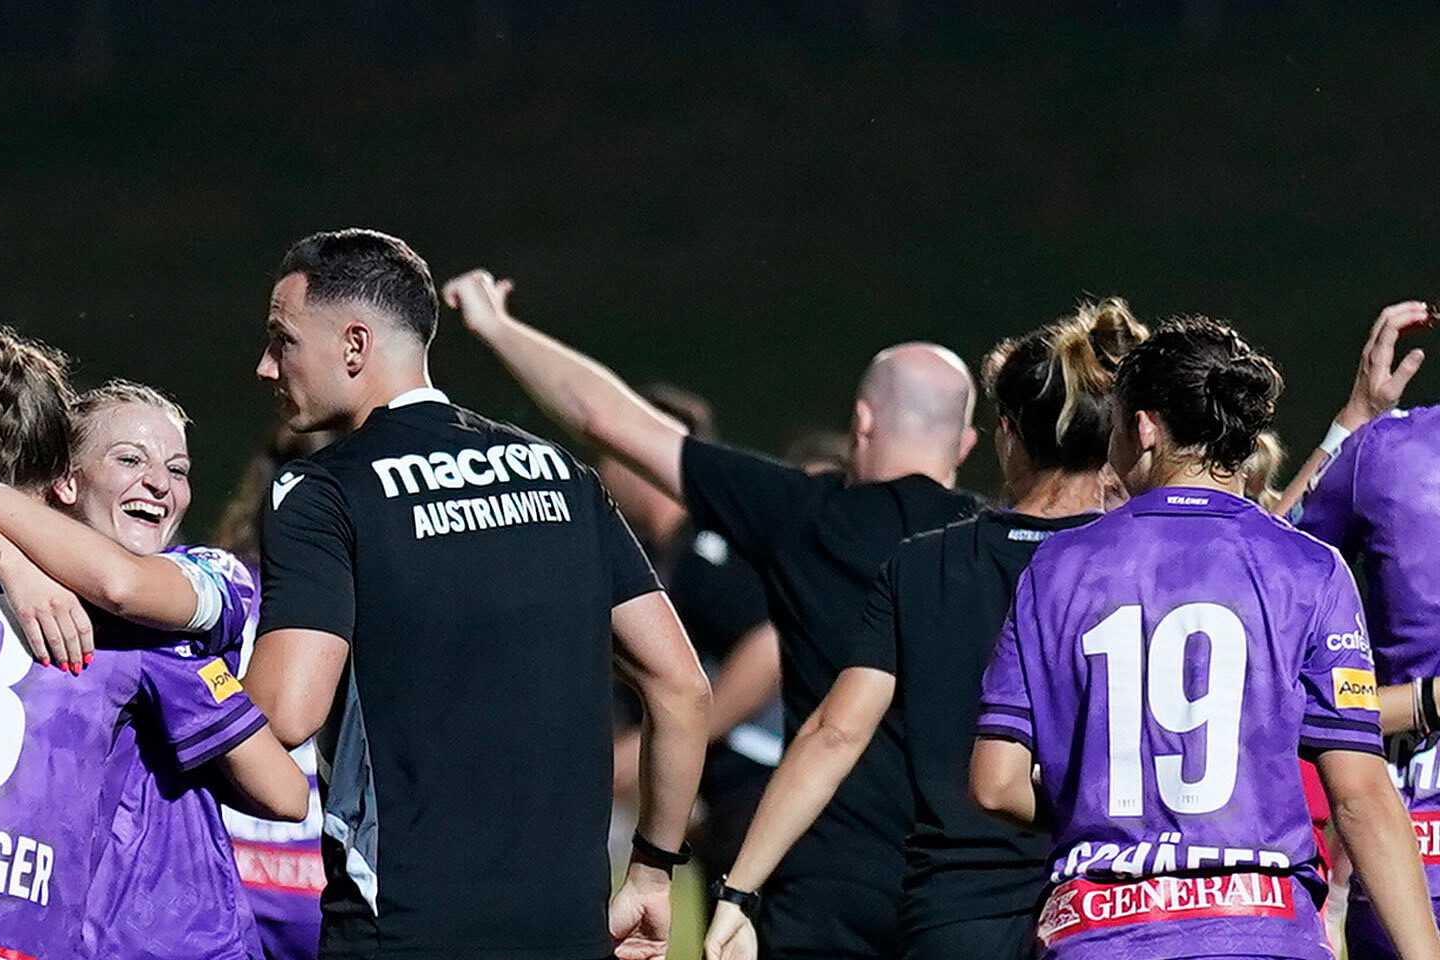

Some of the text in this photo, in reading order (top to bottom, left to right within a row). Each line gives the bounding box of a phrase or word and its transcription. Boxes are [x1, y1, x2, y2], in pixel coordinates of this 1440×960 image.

[371, 443, 569, 498] macron
[413, 491, 571, 539] AUSTRIAWIEN
[1082, 602, 1248, 817] 19
[1082, 872, 1286, 921] GENERALI
